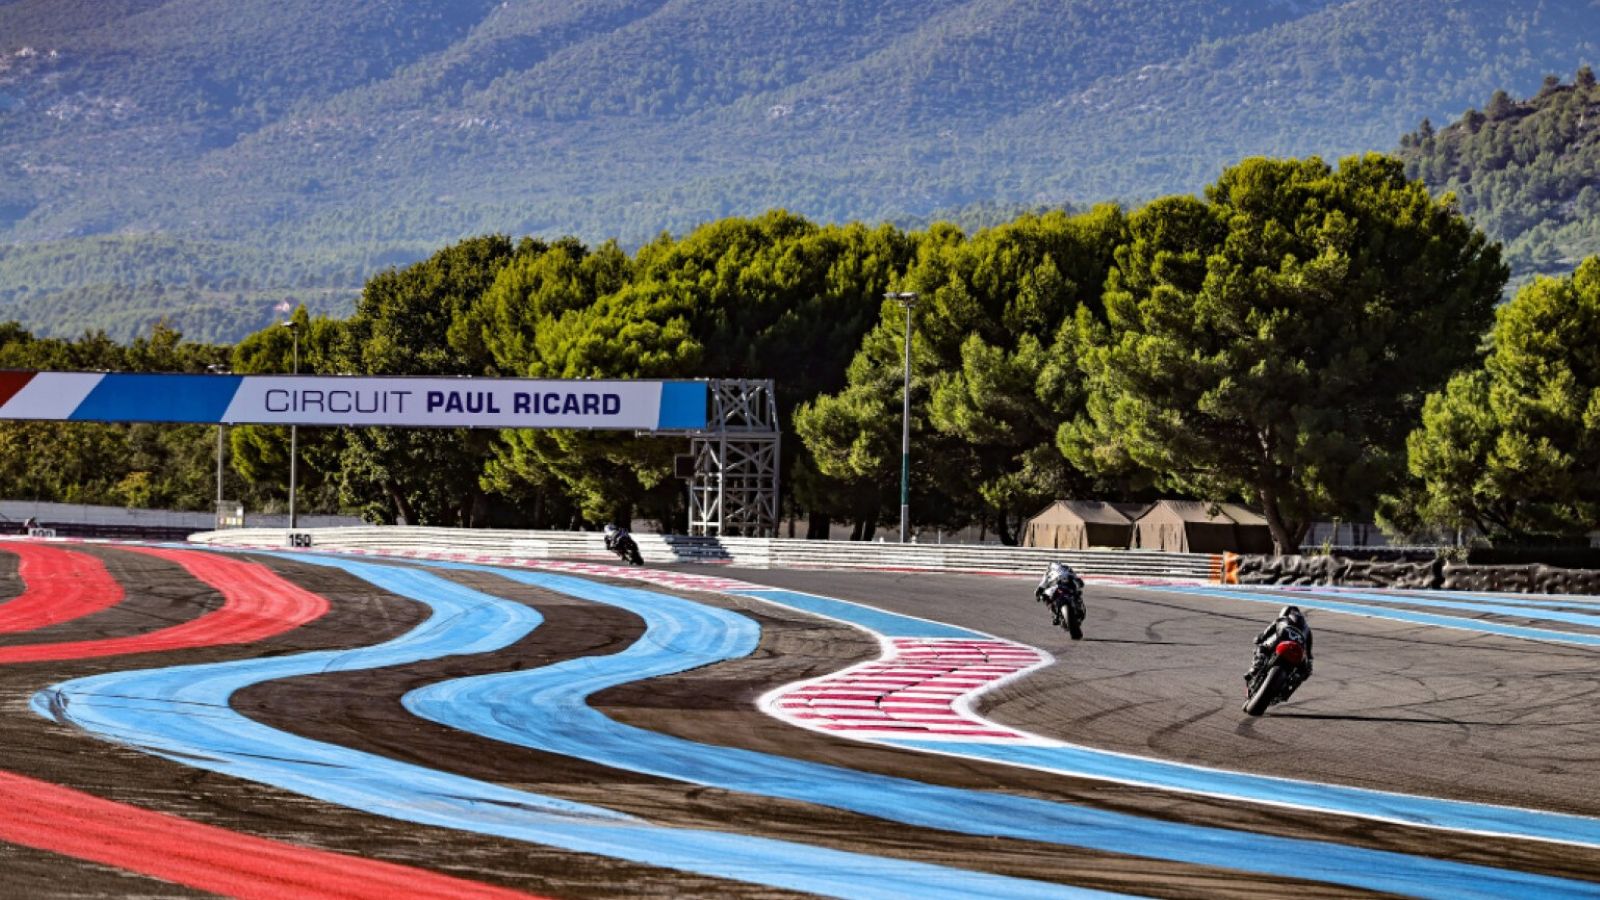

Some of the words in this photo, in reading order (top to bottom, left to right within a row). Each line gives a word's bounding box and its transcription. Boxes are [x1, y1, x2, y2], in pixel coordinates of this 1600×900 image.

[264, 389, 413, 414] CIRCUIT
[426, 390, 502, 414] PAUL
[512, 391, 622, 415] RICARD
[289, 533, 312, 548] 150
